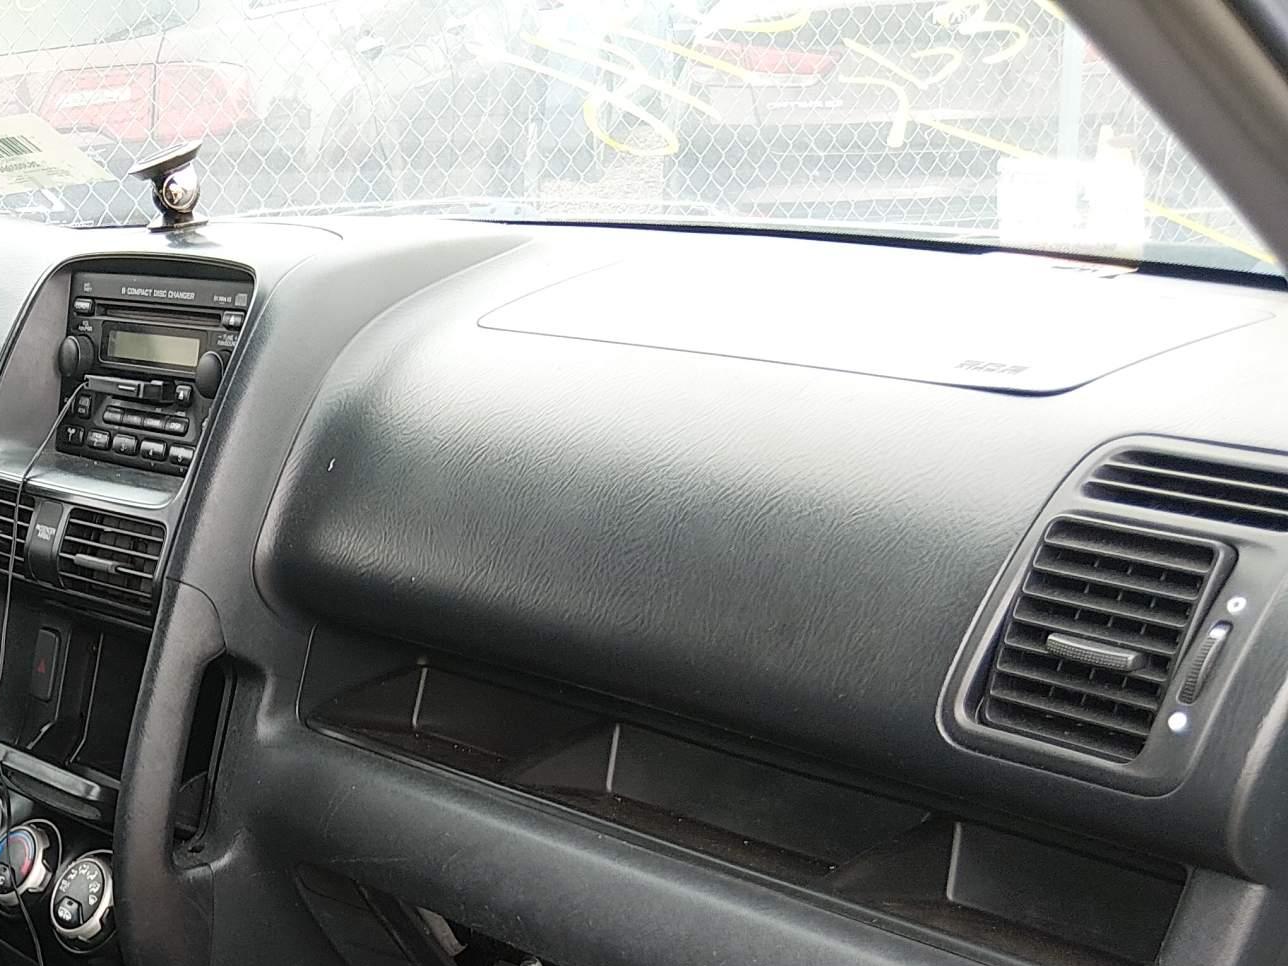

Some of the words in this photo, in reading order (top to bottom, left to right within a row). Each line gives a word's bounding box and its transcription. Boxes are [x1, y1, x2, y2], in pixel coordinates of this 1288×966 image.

[127, 287, 153, 297] COMPACT
[153, 289, 167, 298] DISC
[167, 290, 196, 300] CHANGER
